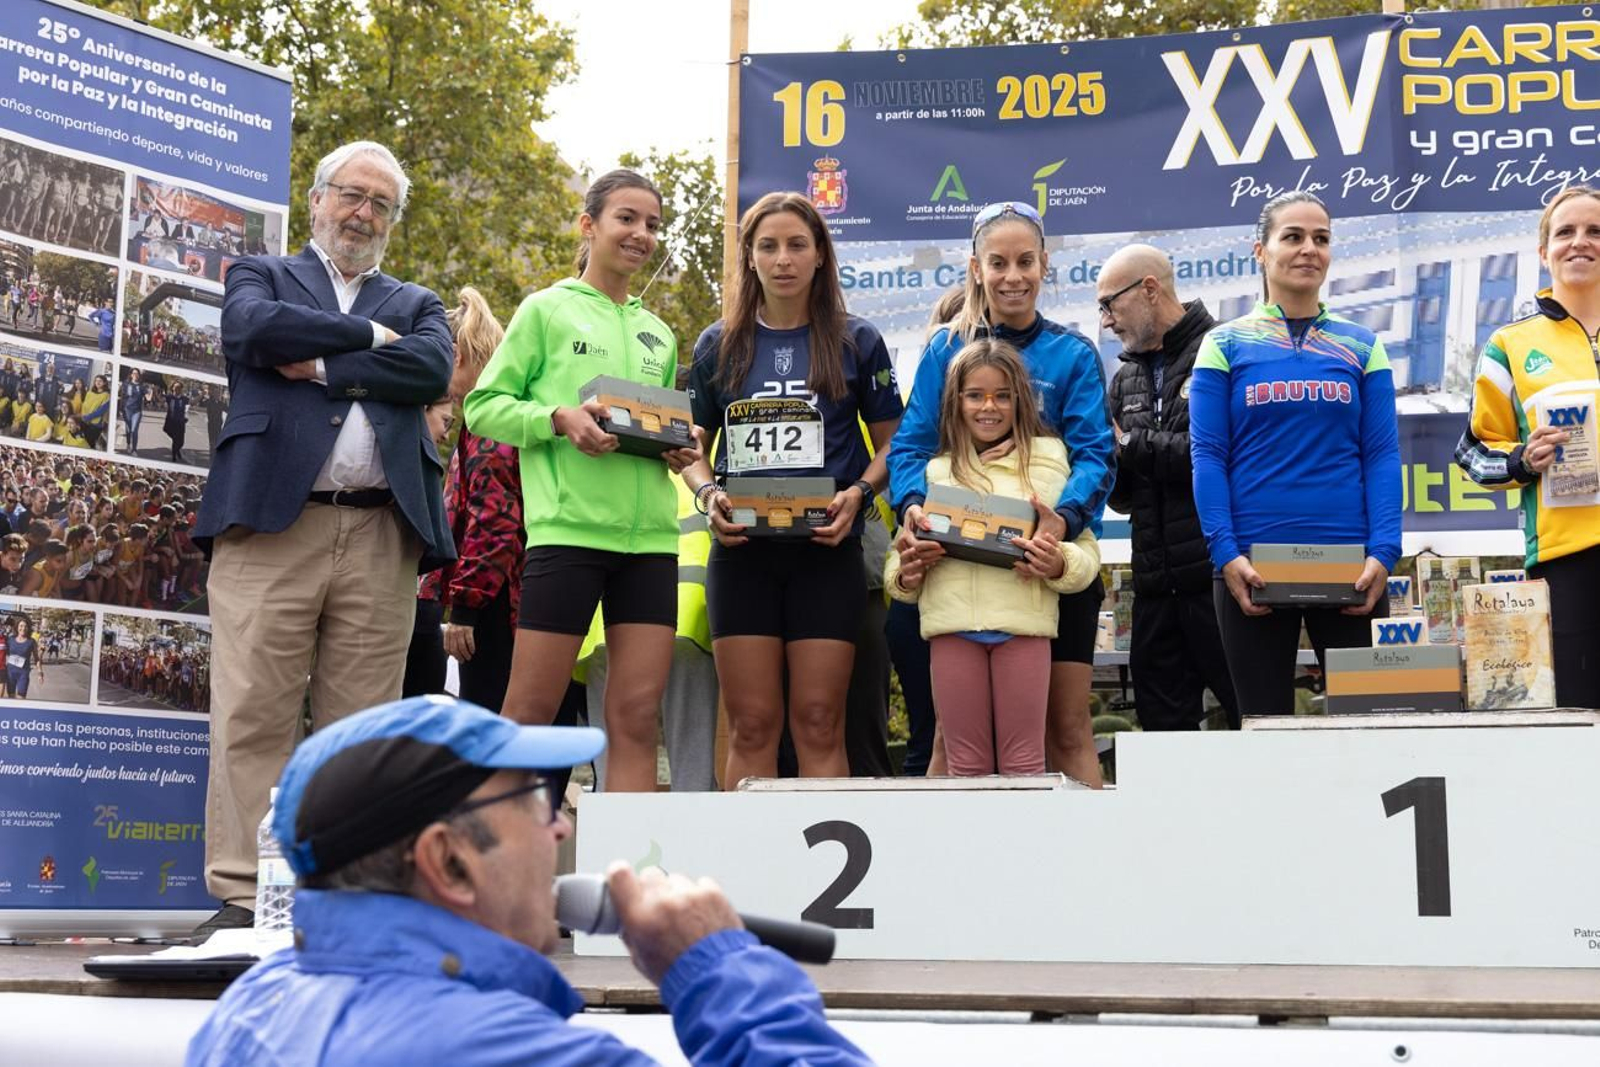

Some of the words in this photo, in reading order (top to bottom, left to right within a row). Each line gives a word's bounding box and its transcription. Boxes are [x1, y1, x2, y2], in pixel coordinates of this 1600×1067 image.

[82, 38, 186, 81] Aniversario
[188, 71, 208, 88] de
[211, 78, 226, 95] la
[58, 52, 129, 86] Popular
[131, 77, 144, 94] y
[145, 80, 187, 105] Gran
[190, 94, 272, 130] Caminata
[1161, 30, 1392, 170] XXV
[18, 66, 50, 86] por
[52, 74, 69, 92] la
[72, 80, 105, 102] Paz
[107, 92, 120, 110] y
[122, 94, 138, 112] la
[141, 100, 238, 142] Integración
[773, 80, 846, 147] 16
[854, 78, 985, 108] NOVIEMBRE
[996, 72, 1106, 120] 2025
[885, 109, 914, 122] partir
[916, 109, 929, 118] de
[932, 108, 948, 118] las
[950, 108, 986, 118] 11:00h
[0, 98, 32, 115] años
[34, 108, 129, 142] compartiendo
[132, 134, 184, 160] deporte,
[187, 150, 213, 166] vida
[215, 159, 222, 172] y
[224, 162, 269, 182] valores
[1410, 130, 1436, 155] y
[1452, 128, 1552, 155] gran
[1049, 186, 1106, 196] DIPUTACIÓN
[1230, 176, 1284, 207] Por
[1294, 165, 1328, 194] la
[1341, 166, 1400, 202] Paz
[1391, 173, 1431, 210] y
[1440, 156, 1476, 188] la
[907, 204, 932, 214] Junta
[935, 204, 946, 212] de
[948, 202, 989, 212] Andaluc
[1064, 196, 1088, 206] JAÉN
[839, 264, 922, 288] Santa
[1255, 380, 1352, 405] BRUTUS
[730, 403, 750, 418] XXV
[1547, 405, 1588, 426] XXV
[745, 426, 802, 452] 412
[1474, 591, 1535, 614] Rotalaya
[1378, 622, 1422, 645] XXV
[1482, 658, 1532, 672] Ecológico
[0, 720, 10, 730] a
[14, 720, 52, 732] todas
[54, 721, 74, 733] las
[76, 724, 134, 738] personas,
[136, 726, 211, 742] instituciones
[12, 736, 38, 748] que
[42, 735, 66, 747] han
[70, 736, 106, 750] hecho
[109, 740, 153, 754] posible
[156, 744, 181, 754] este
[27, 762, 84, 778] corriendo
[80, 764, 117, 784] juntos
[118, 765, 148, 781] hacia
[150, 768, 160, 782] el
[160, 770, 196, 787] futuro.
[6, 810, 28, 818] SANTA
[94, 805, 118, 827] 25
[1381, 776, 1452, 916] 1
[800, 820, 874, 930] 2
